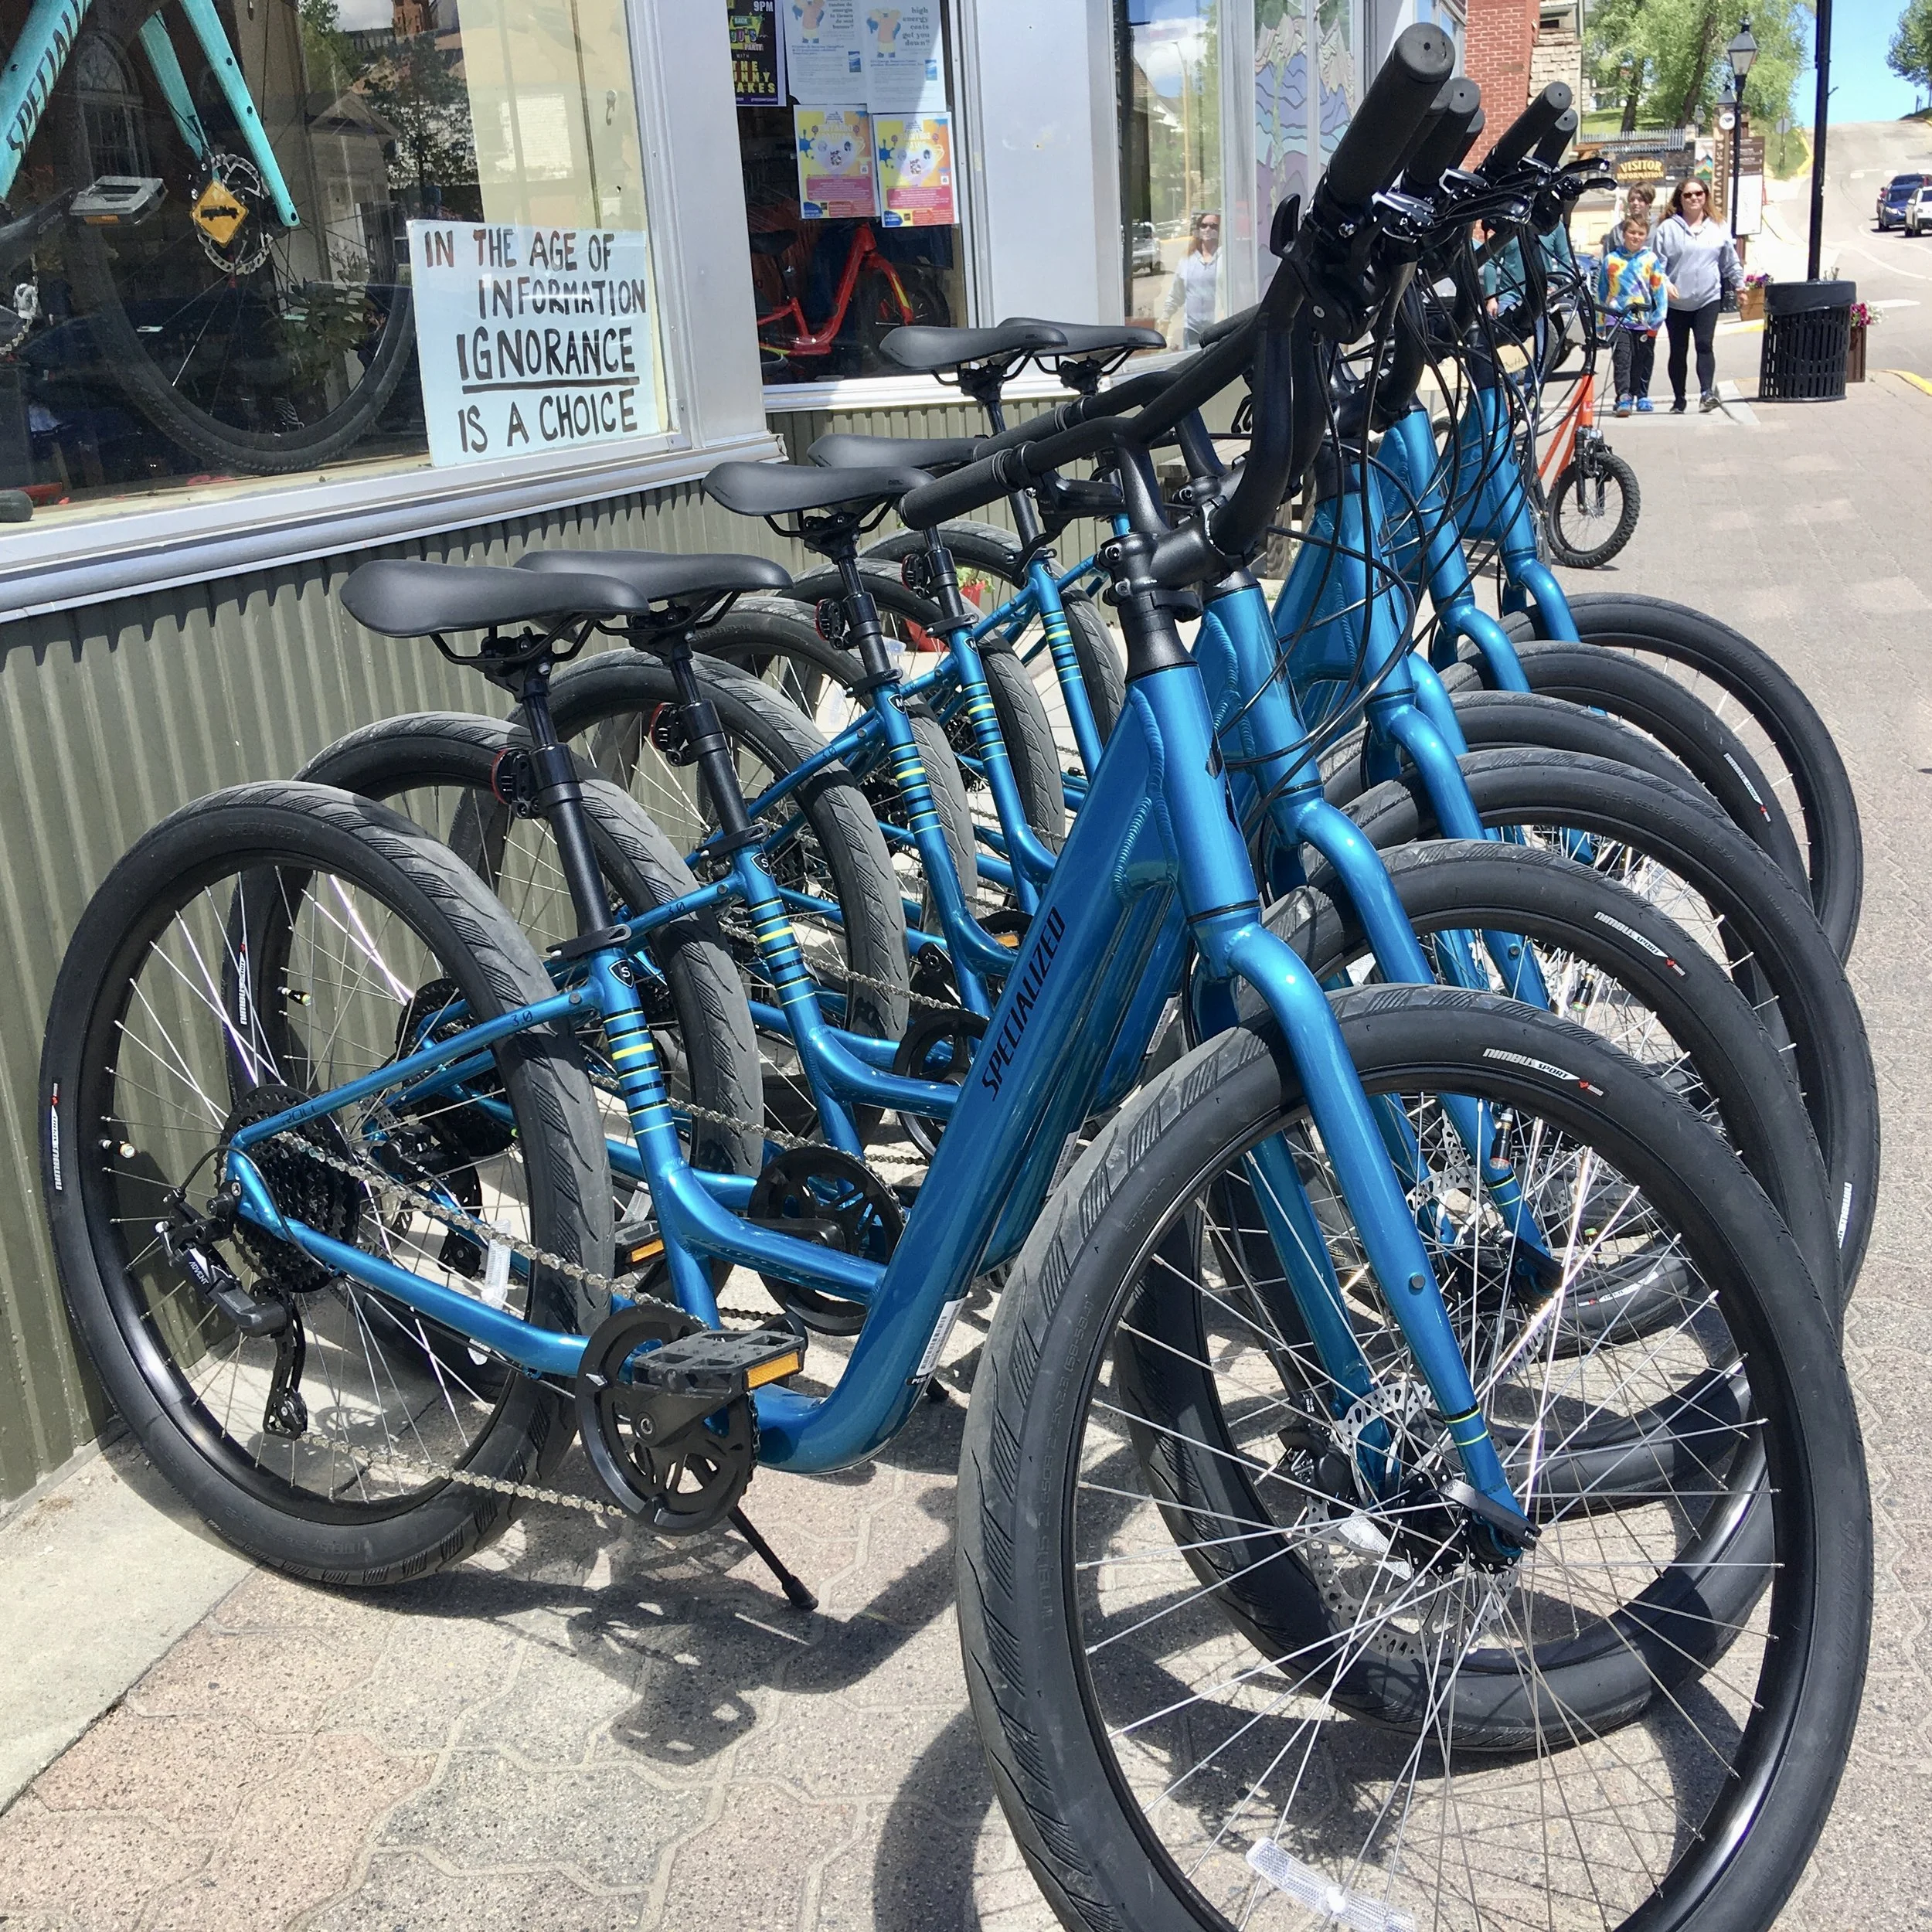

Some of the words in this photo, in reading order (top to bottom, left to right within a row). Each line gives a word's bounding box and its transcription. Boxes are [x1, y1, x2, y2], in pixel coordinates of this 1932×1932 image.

[753, 1, 774, 12] 9PM
[1617, 171, 1664, 180] INFORMATION
[1620, 160, 1662, 172] VISITOR
[424, 230, 454, 267] IN
[473, 227, 517, 267] THE
[529, 231, 578, 271] AGE
[588, 233, 615, 272] OF
[478, 276, 647, 319] INFORMATION
[456, 325, 636, 381] IGNORANCE
[458, 404, 488, 454] IS
[507, 401, 530, 447] A
[540, 387, 638, 442] CHOICE
[760, 858, 769, 868] S
[621, 966, 631, 978] S
[981, 906, 1066, 1102] SPECIALIZED
[1537, 1063, 1569, 1079] SPORT
[189, 1261, 209, 1285] ADVENT
